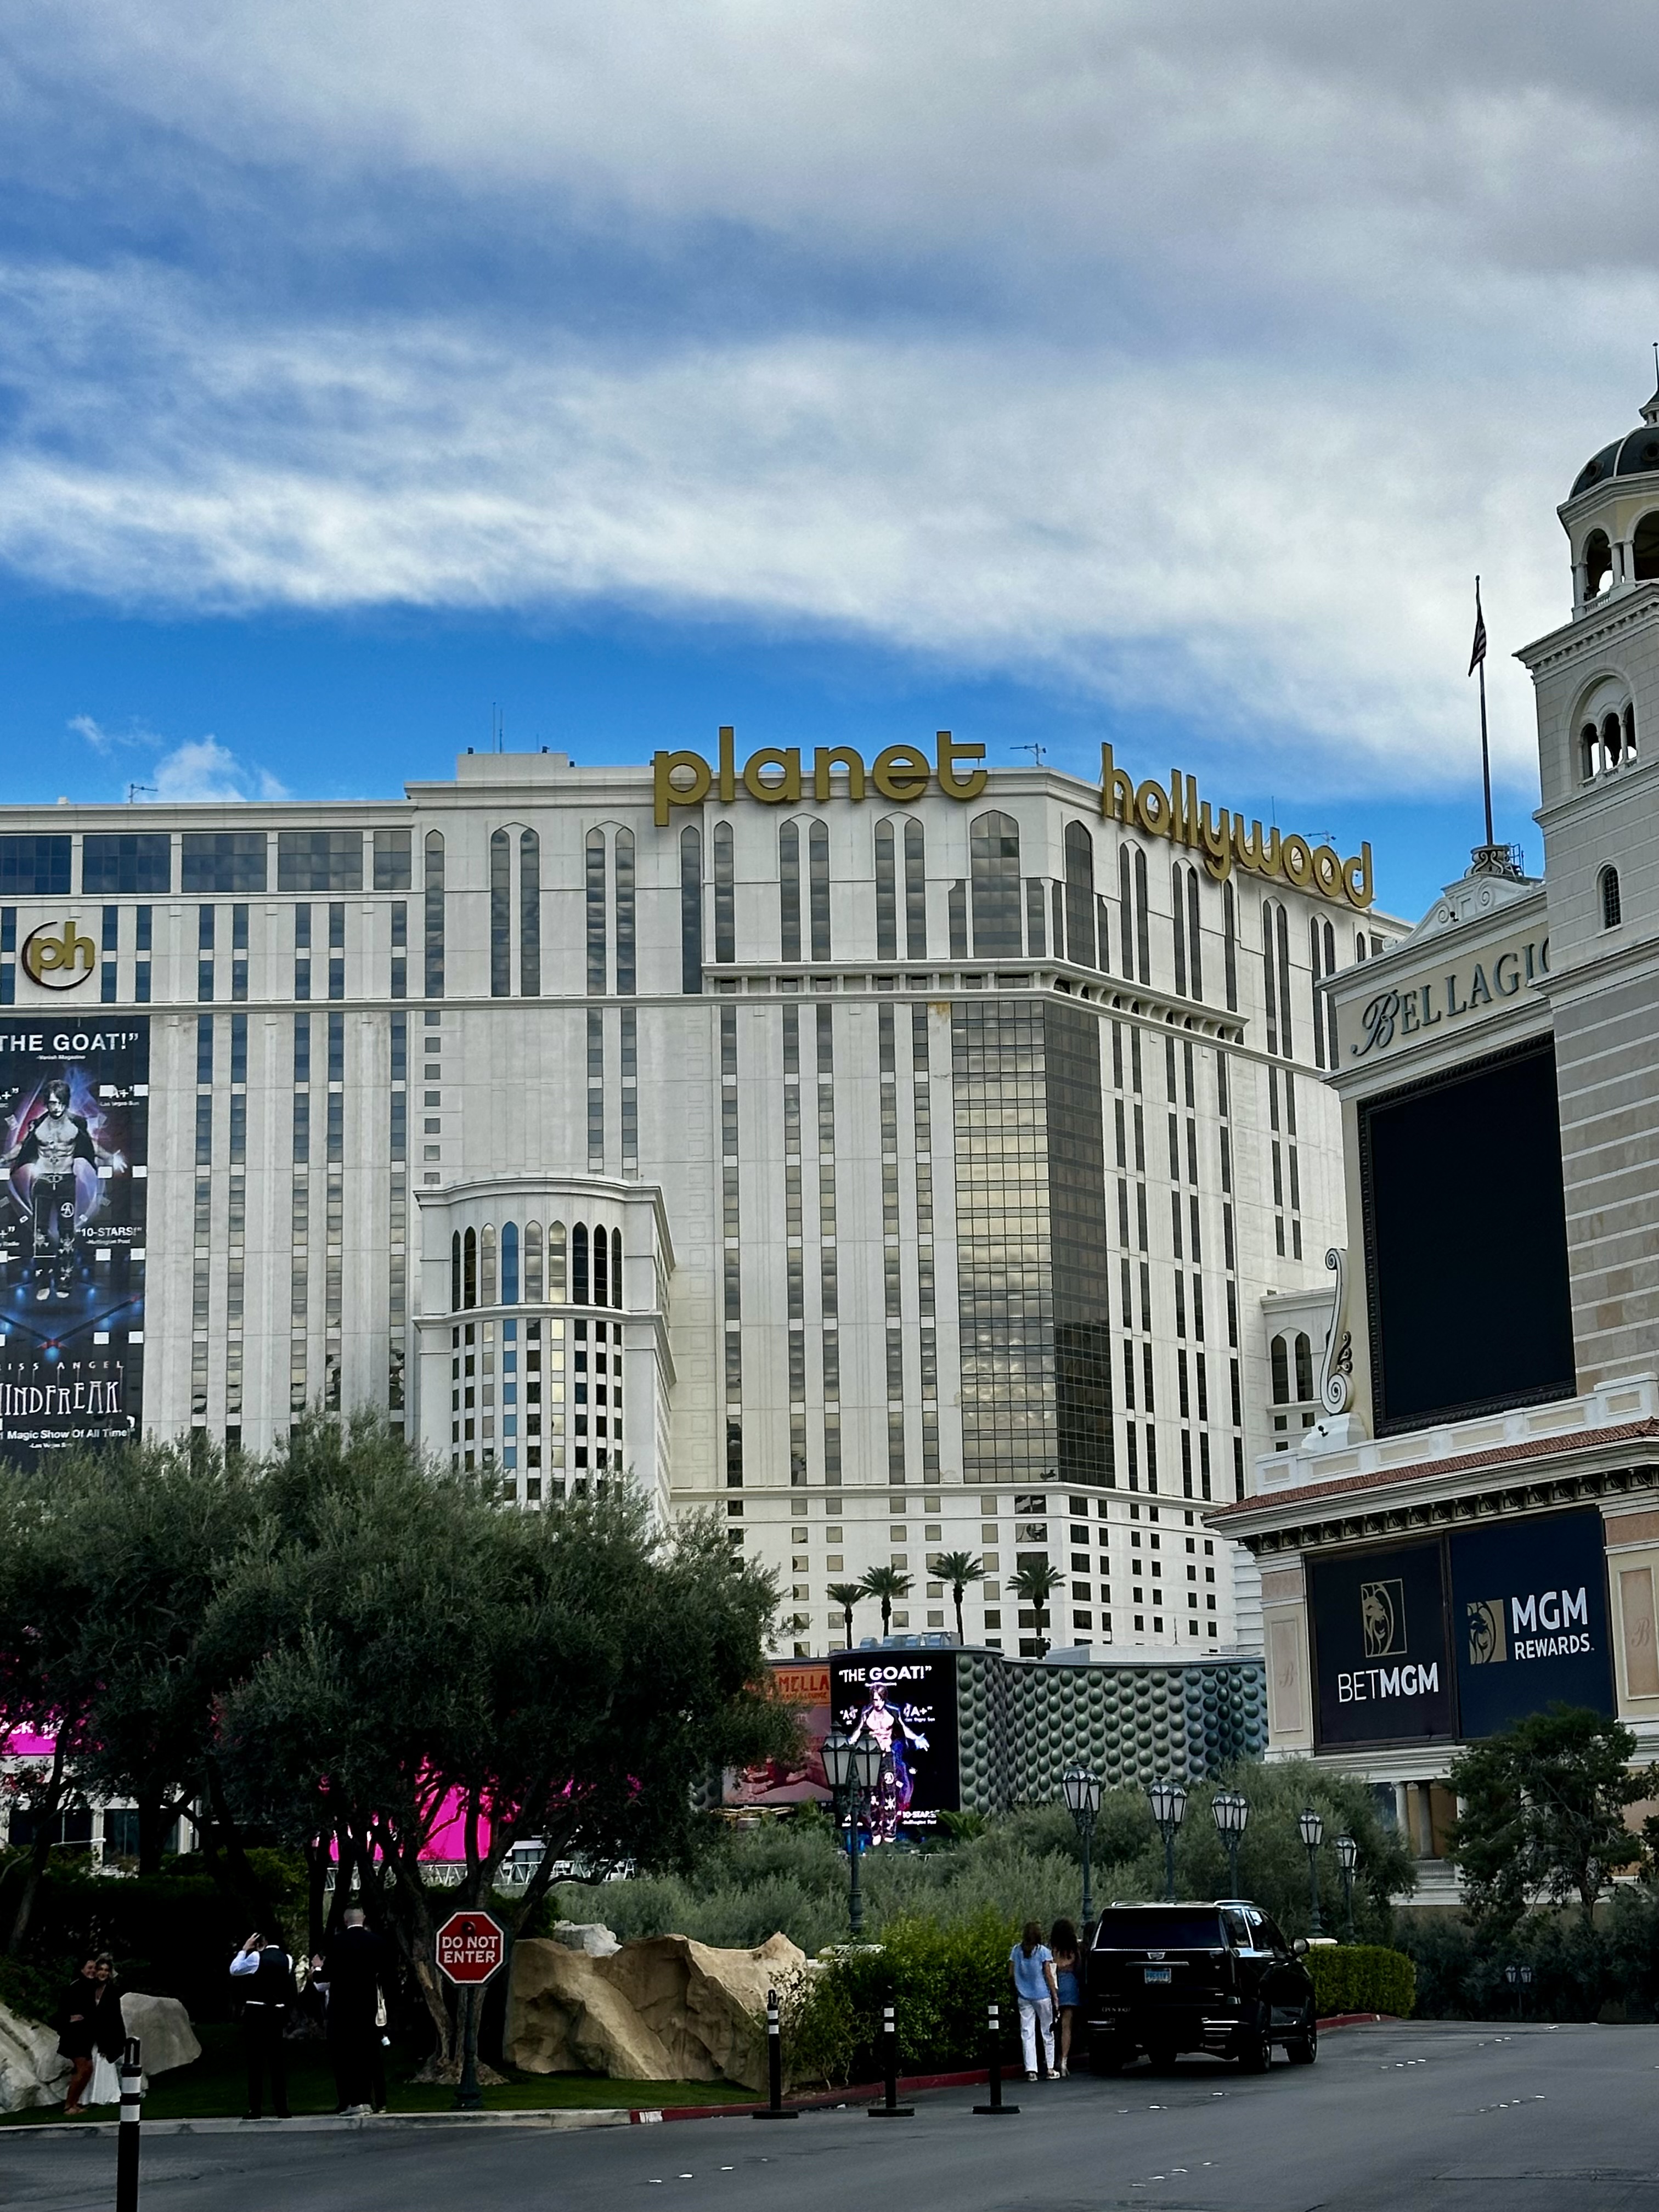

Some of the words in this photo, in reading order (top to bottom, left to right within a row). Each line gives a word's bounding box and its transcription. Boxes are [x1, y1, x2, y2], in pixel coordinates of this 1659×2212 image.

[654, 726, 988, 826] planet
[1101, 742, 1373, 909] hollywood
[31, 921, 95, 980] ph
[0, 1362, 40, 1370] ISS
[57, 1361, 125, 1370] ANGEL
[7, 1429, 39, 1441] Magic
[40, 1429, 71, 1439] Show
[86, 1428, 100, 1438] All
[1511, 1587, 1588, 1634] MGM
[778, 1674, 830, 1692] MELLA
[1338, 1662, 1439, 1703] BETMGM
[442, 1936, 463, 1949] DO
[467, 1936, 499, 1949] NOT
[443, 1950, 495, 1964] ENTER
